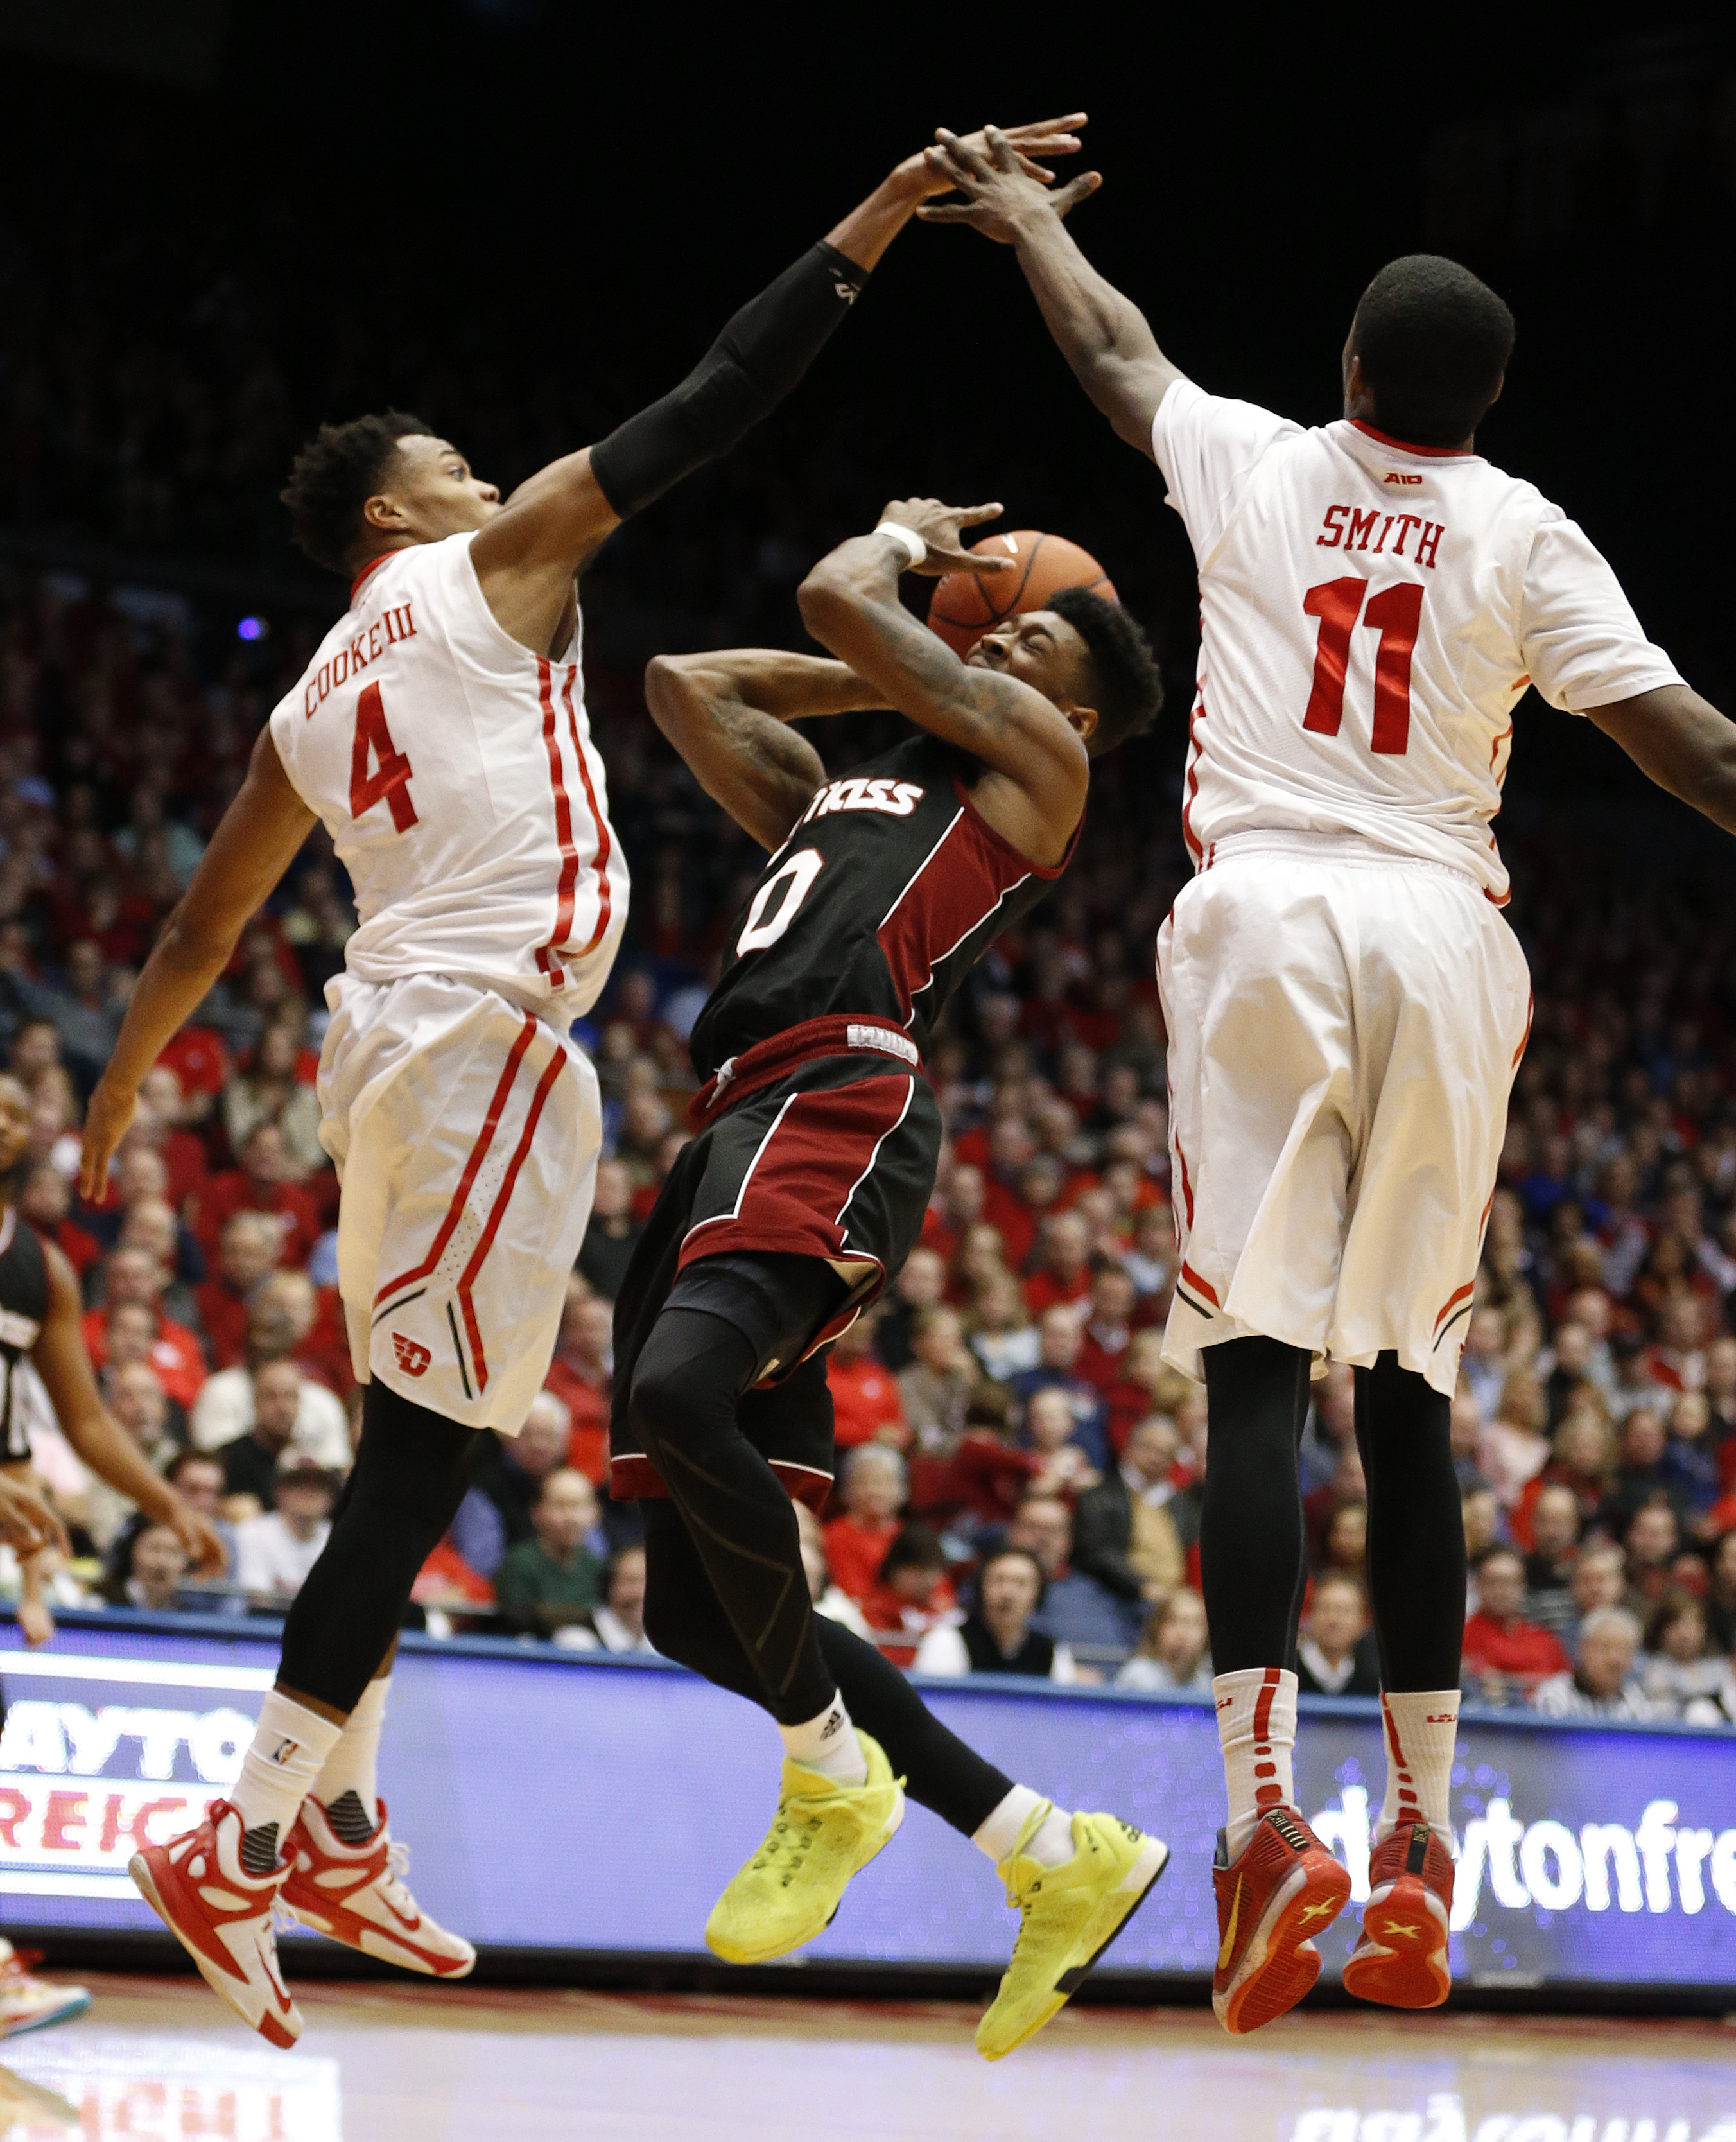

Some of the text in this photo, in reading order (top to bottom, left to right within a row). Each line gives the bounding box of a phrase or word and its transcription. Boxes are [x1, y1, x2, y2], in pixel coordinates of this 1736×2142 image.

[1316, 504, 1445, 569] SMITH
[304, 604, 417, 720] COOKE III
[1301, 575, 1425, 756] 11
[349, 679, 419, 835] 4
[734, 848, 825, 959] 0
[1309, 1785, 1736, 1931] dytonfr
